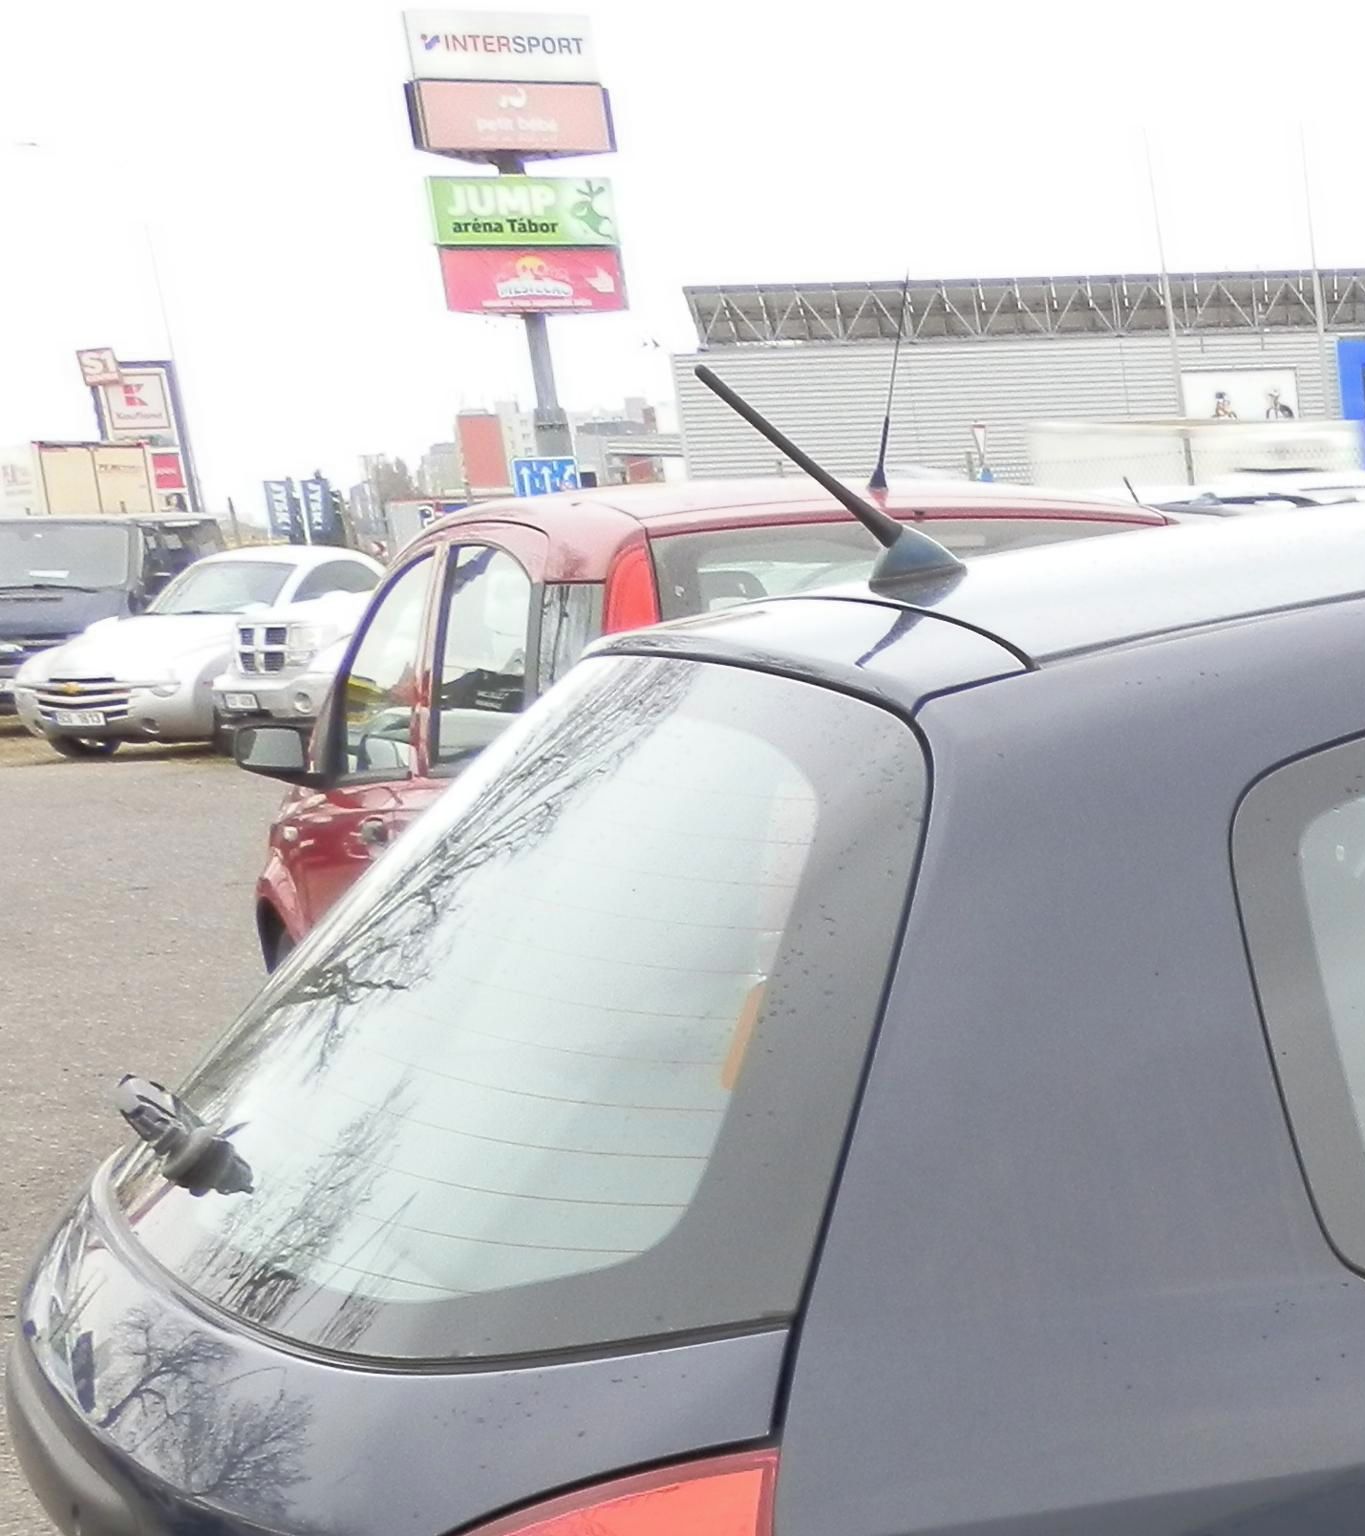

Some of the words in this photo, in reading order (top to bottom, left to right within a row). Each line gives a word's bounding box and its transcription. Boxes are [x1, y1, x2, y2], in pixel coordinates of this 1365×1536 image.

[444, 33, 583, 55] INTERSPORT
[447, 183, 557, 217] JUMP
[453, 218, 504, 233] aréna
[506, 218, 559, 234] Tábor
